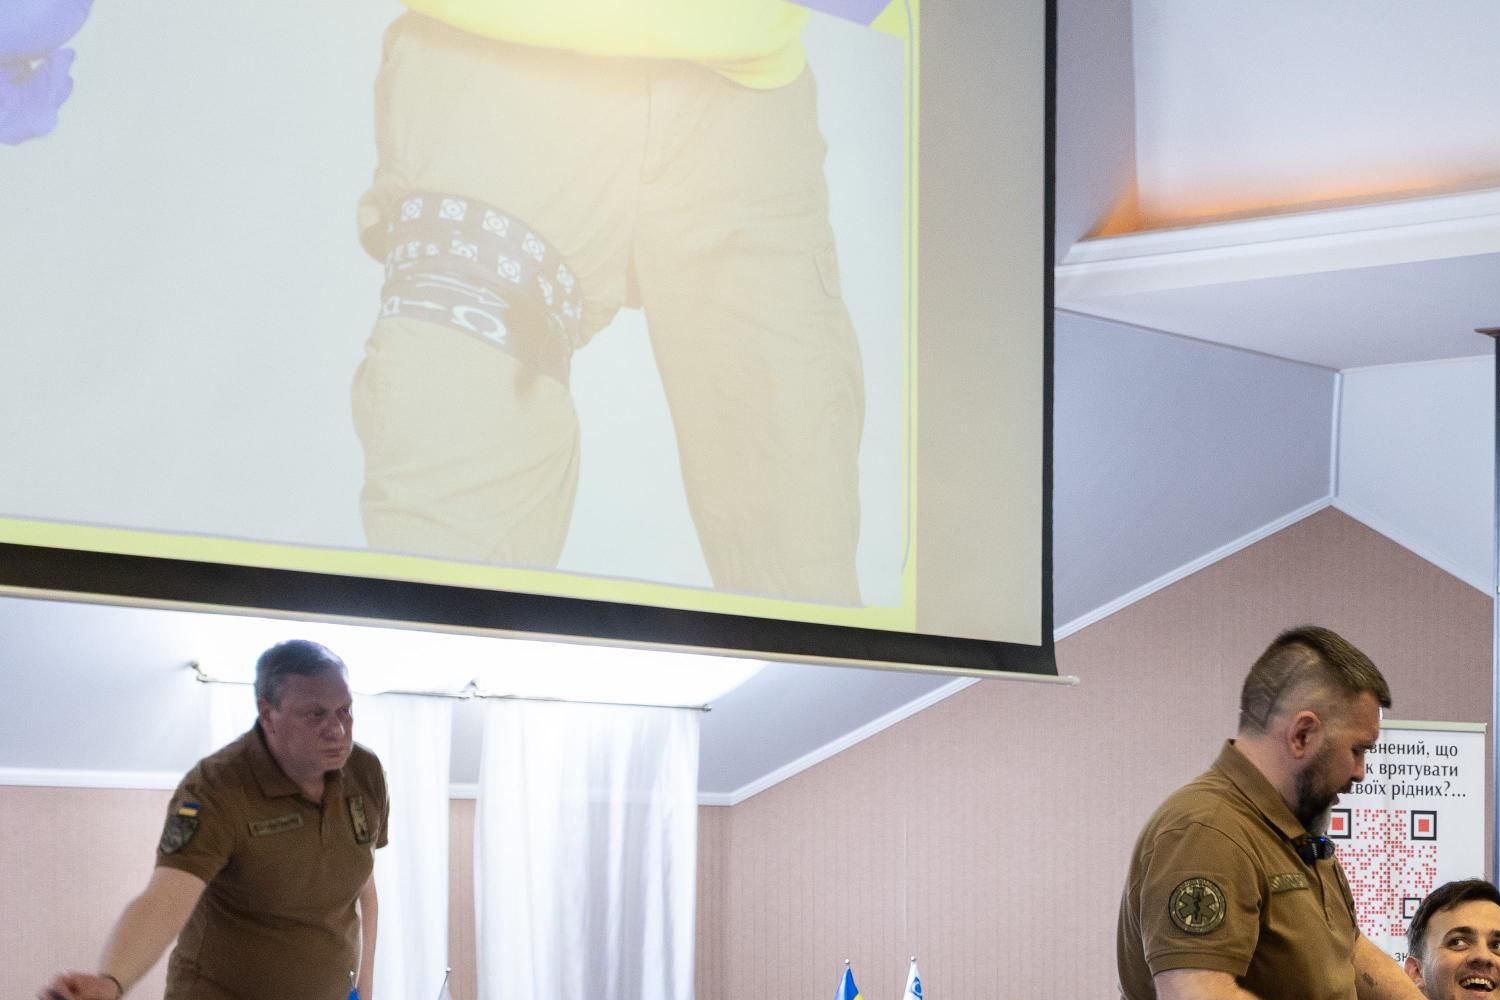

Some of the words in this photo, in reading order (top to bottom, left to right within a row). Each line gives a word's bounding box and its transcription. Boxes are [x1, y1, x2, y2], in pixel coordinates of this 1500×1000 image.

[1364, 740, 1430, 758] внений,
[1436, 744, 1458, 759] що
[1379, 763, 1458, 781] врятувати
[1350, 779, 1386, 795] воїх
